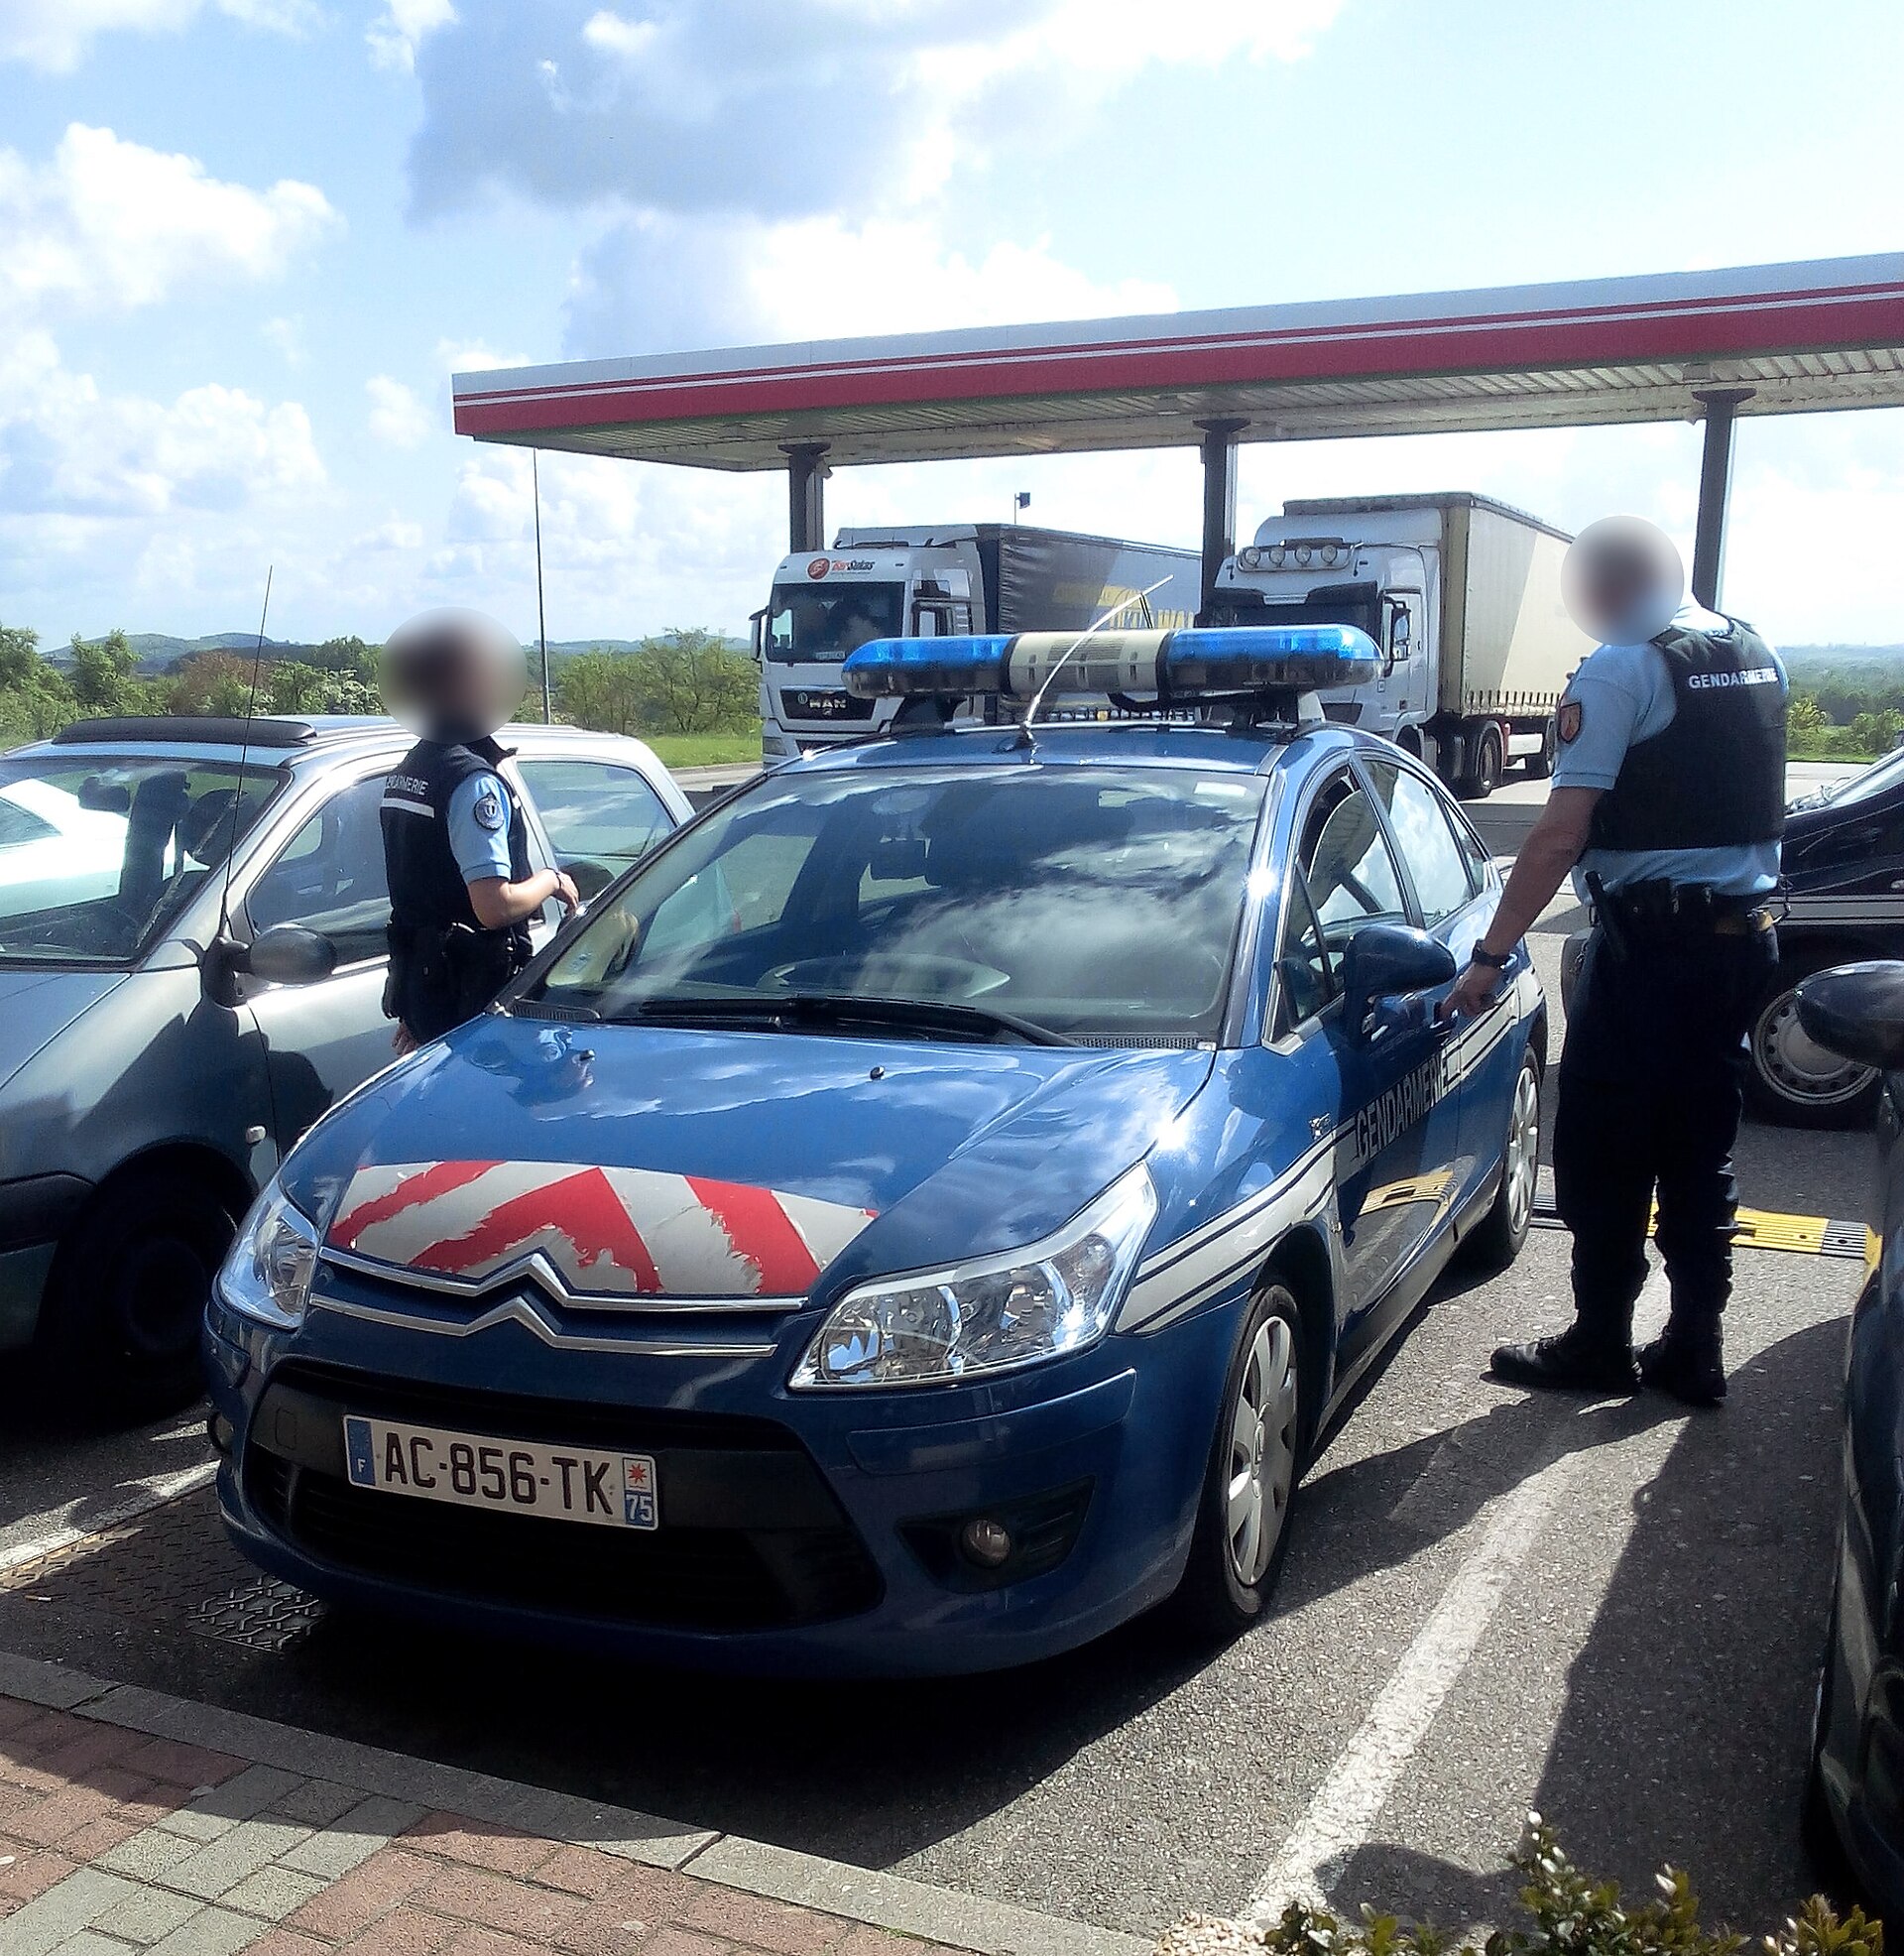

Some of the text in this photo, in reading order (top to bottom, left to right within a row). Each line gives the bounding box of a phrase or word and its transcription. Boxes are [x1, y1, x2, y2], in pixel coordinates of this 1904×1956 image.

[1689, 668, 1778, 688] GENDARMERIE
[809, 698, 846, 708] MAN
[1357, 1049, 1449, 1159] GENDARMERIE
[357, 1458, 366, 1474] F
[384, 1432, 613, 1515] AC-856-TK
[626, 1494, 654, 1522] 75
